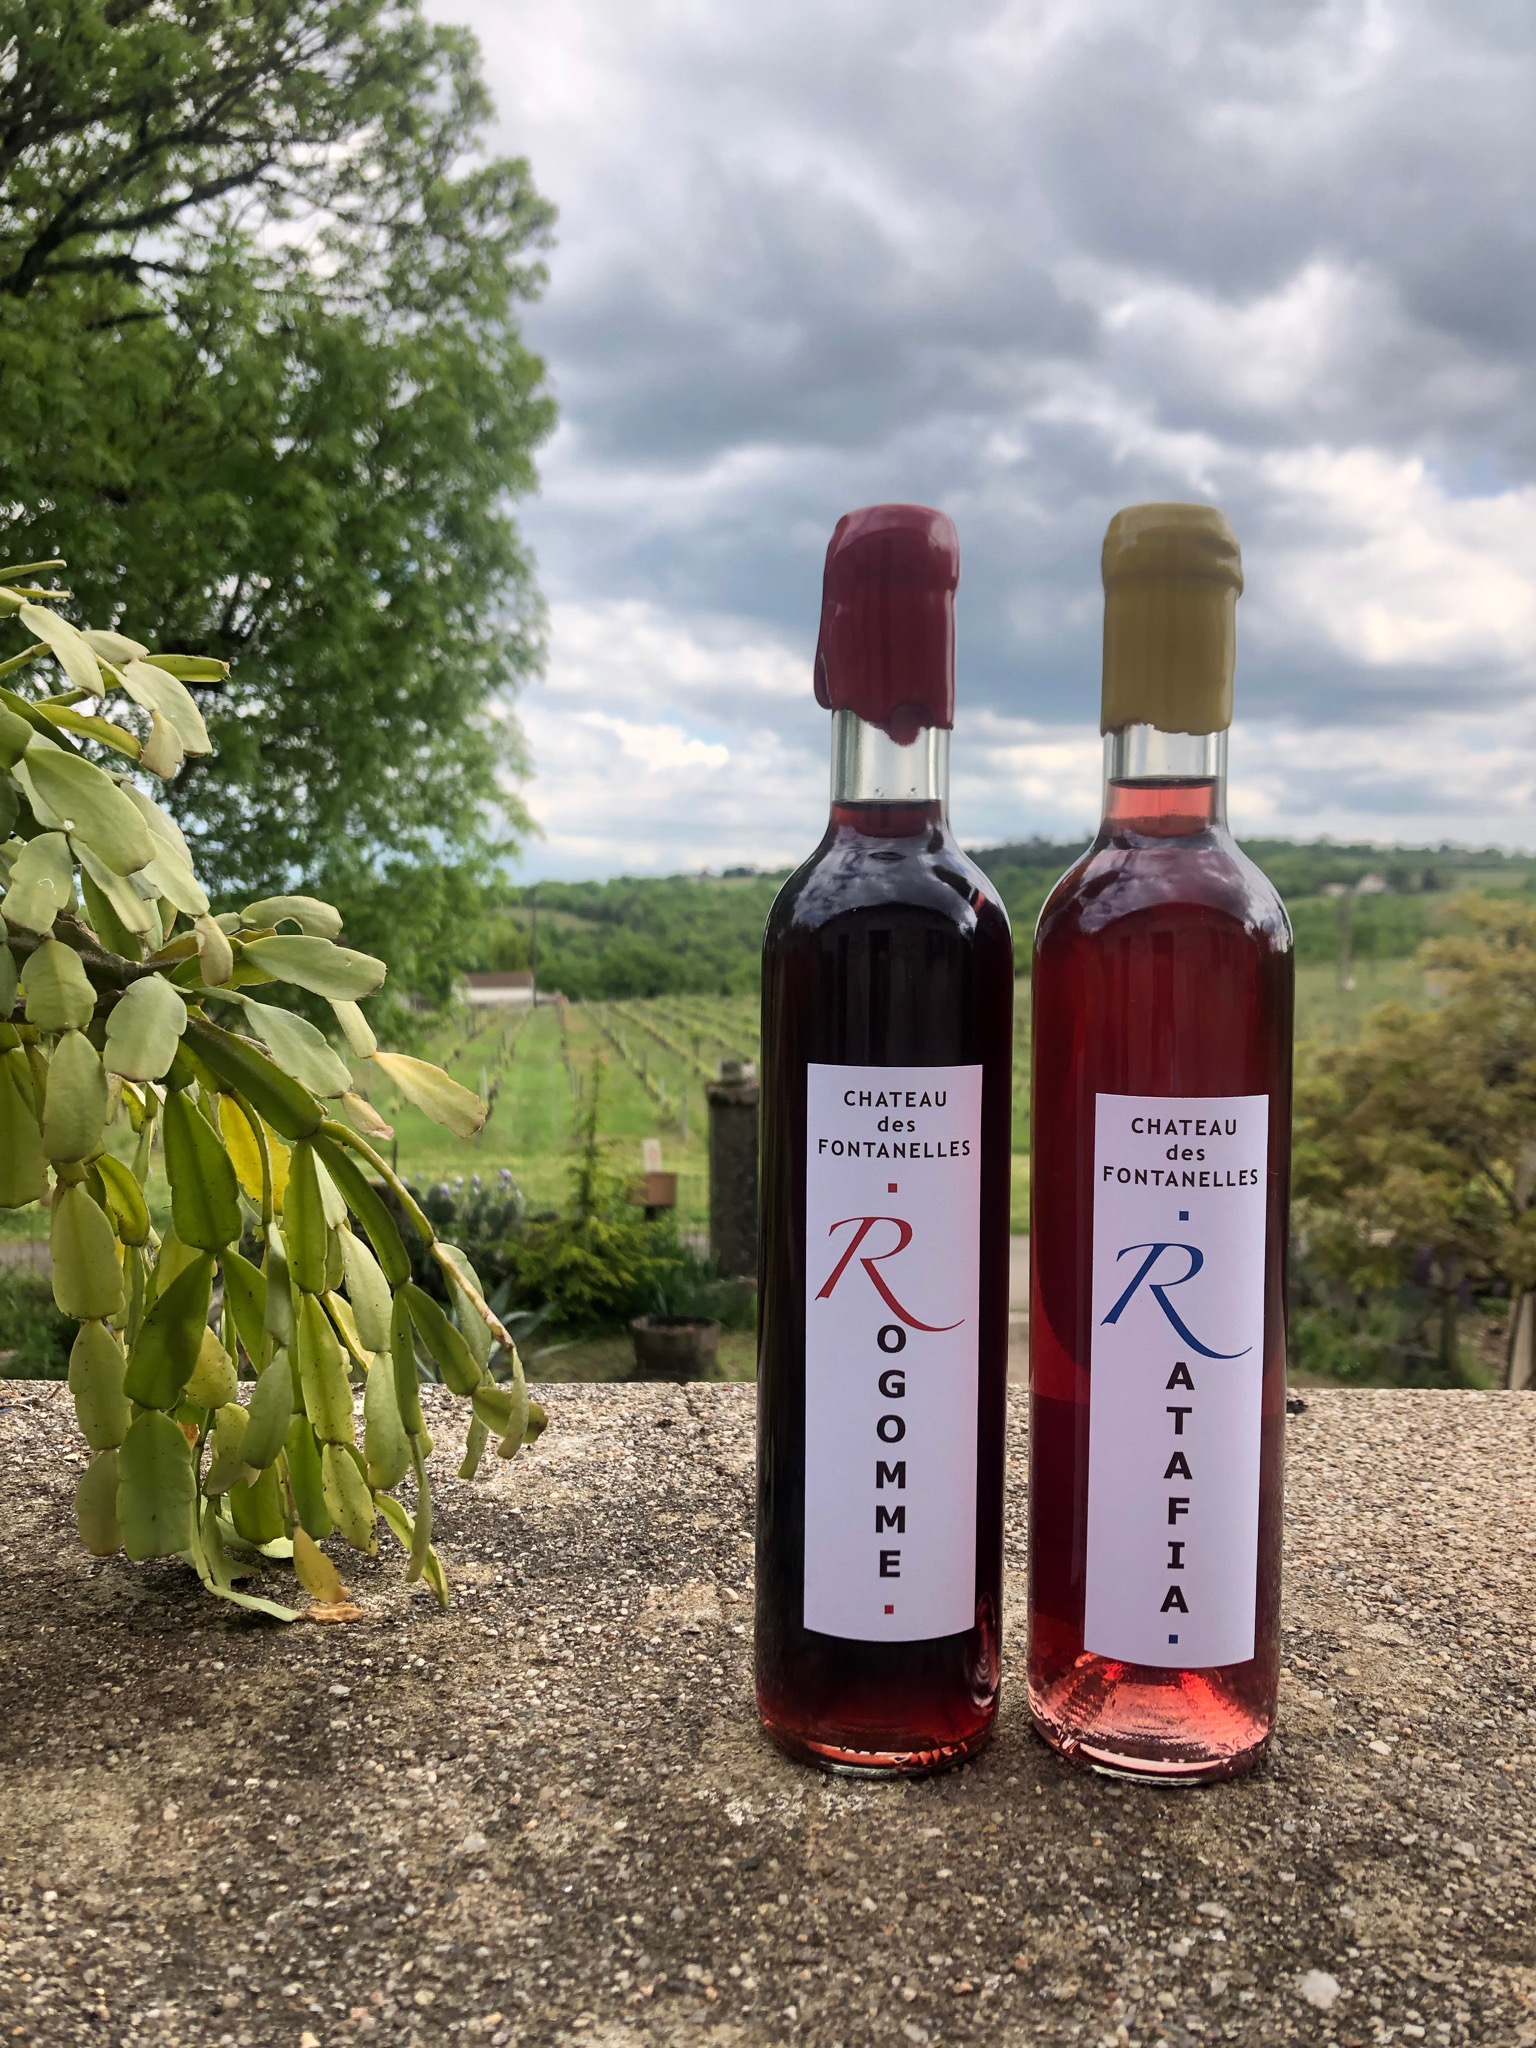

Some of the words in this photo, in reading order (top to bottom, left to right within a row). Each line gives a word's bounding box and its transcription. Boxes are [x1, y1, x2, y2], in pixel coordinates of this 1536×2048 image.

[843, 1089, 947, 1108] CHATEAU
[876, 1115, 916, 1133] des
[1130, 1117, 1237, 1136] CHATEAU
[818, 1138, 971, 1159] FONTANELLES
[1165, 1143, 1206, 1162] des
[1103, 1165, 1258, 1188] FONTANELLES
